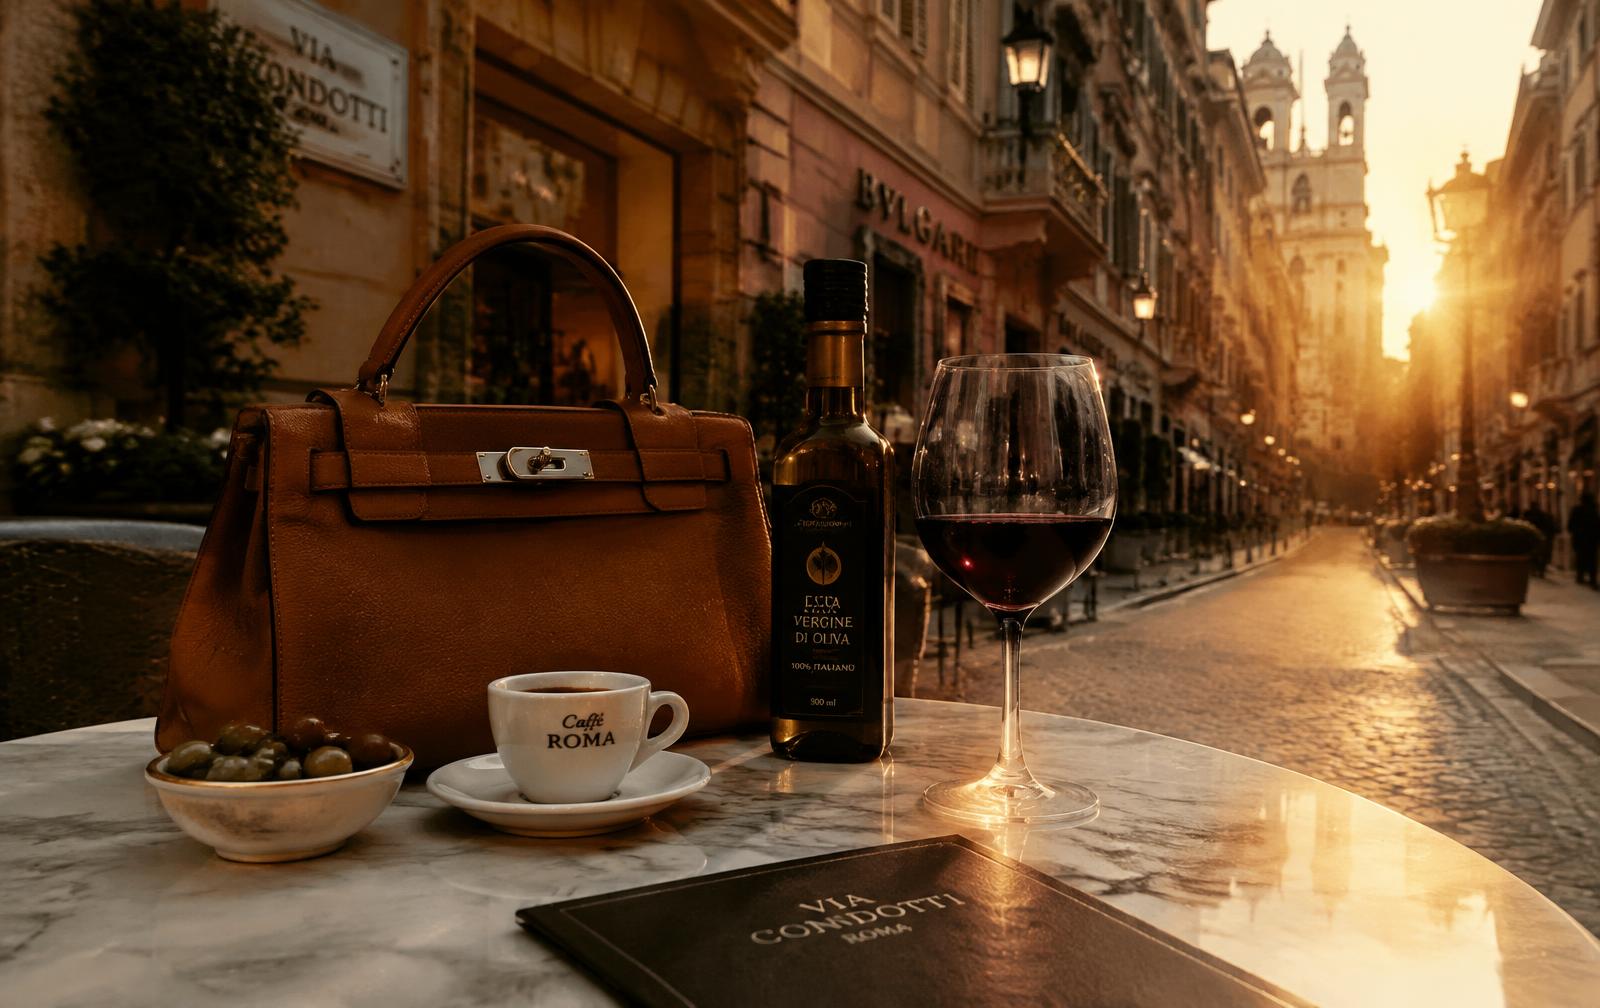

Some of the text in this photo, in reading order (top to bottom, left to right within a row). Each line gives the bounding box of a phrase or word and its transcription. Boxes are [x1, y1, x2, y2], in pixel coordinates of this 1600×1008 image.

[290, 25, 337, 72] VIA
[794, 615, 854, 629] VERGINE
[795, 632, 808, 644] DI
[547, 731, 616, 749] ROMA
[799, 894, 876, 913] VIA
[841, 923, 913, 944] ROMA
